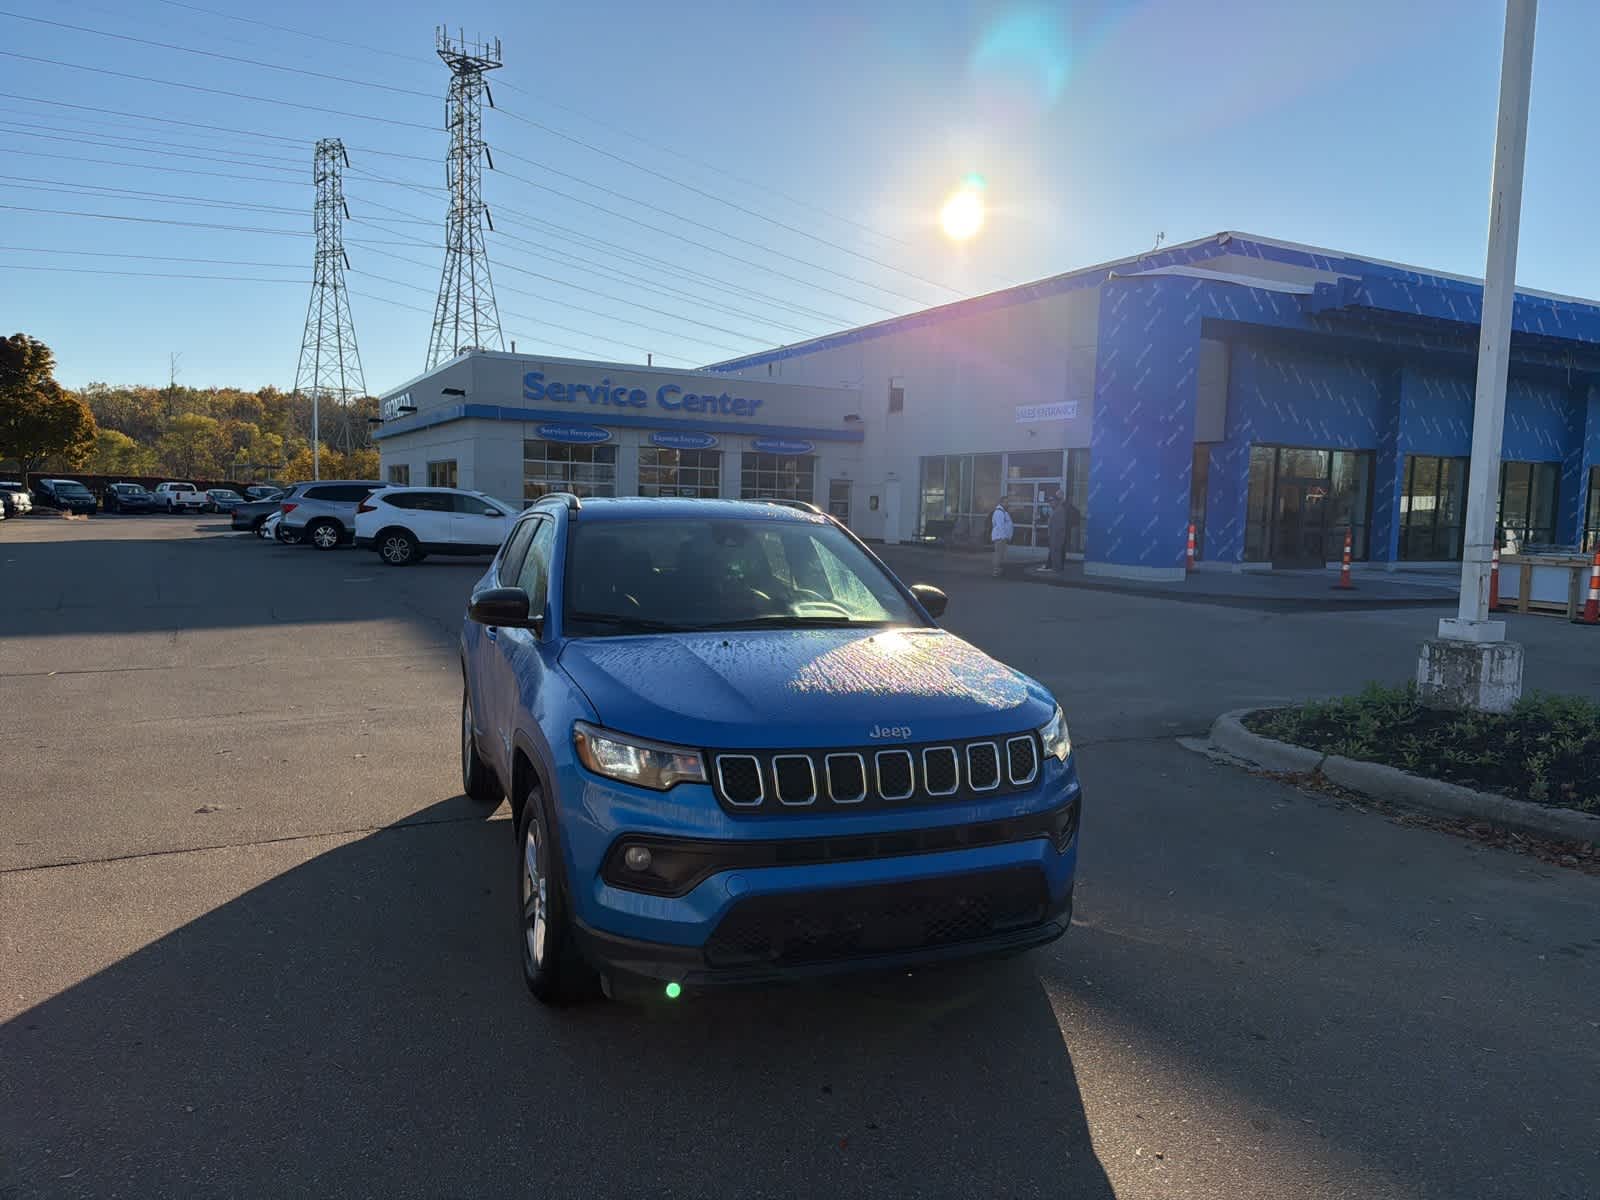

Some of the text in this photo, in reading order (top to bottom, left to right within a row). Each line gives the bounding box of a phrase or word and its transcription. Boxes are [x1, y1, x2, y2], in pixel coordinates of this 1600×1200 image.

[523, 370, 764, 416] Service Center
[869, 725, 912, 739] Jeep
